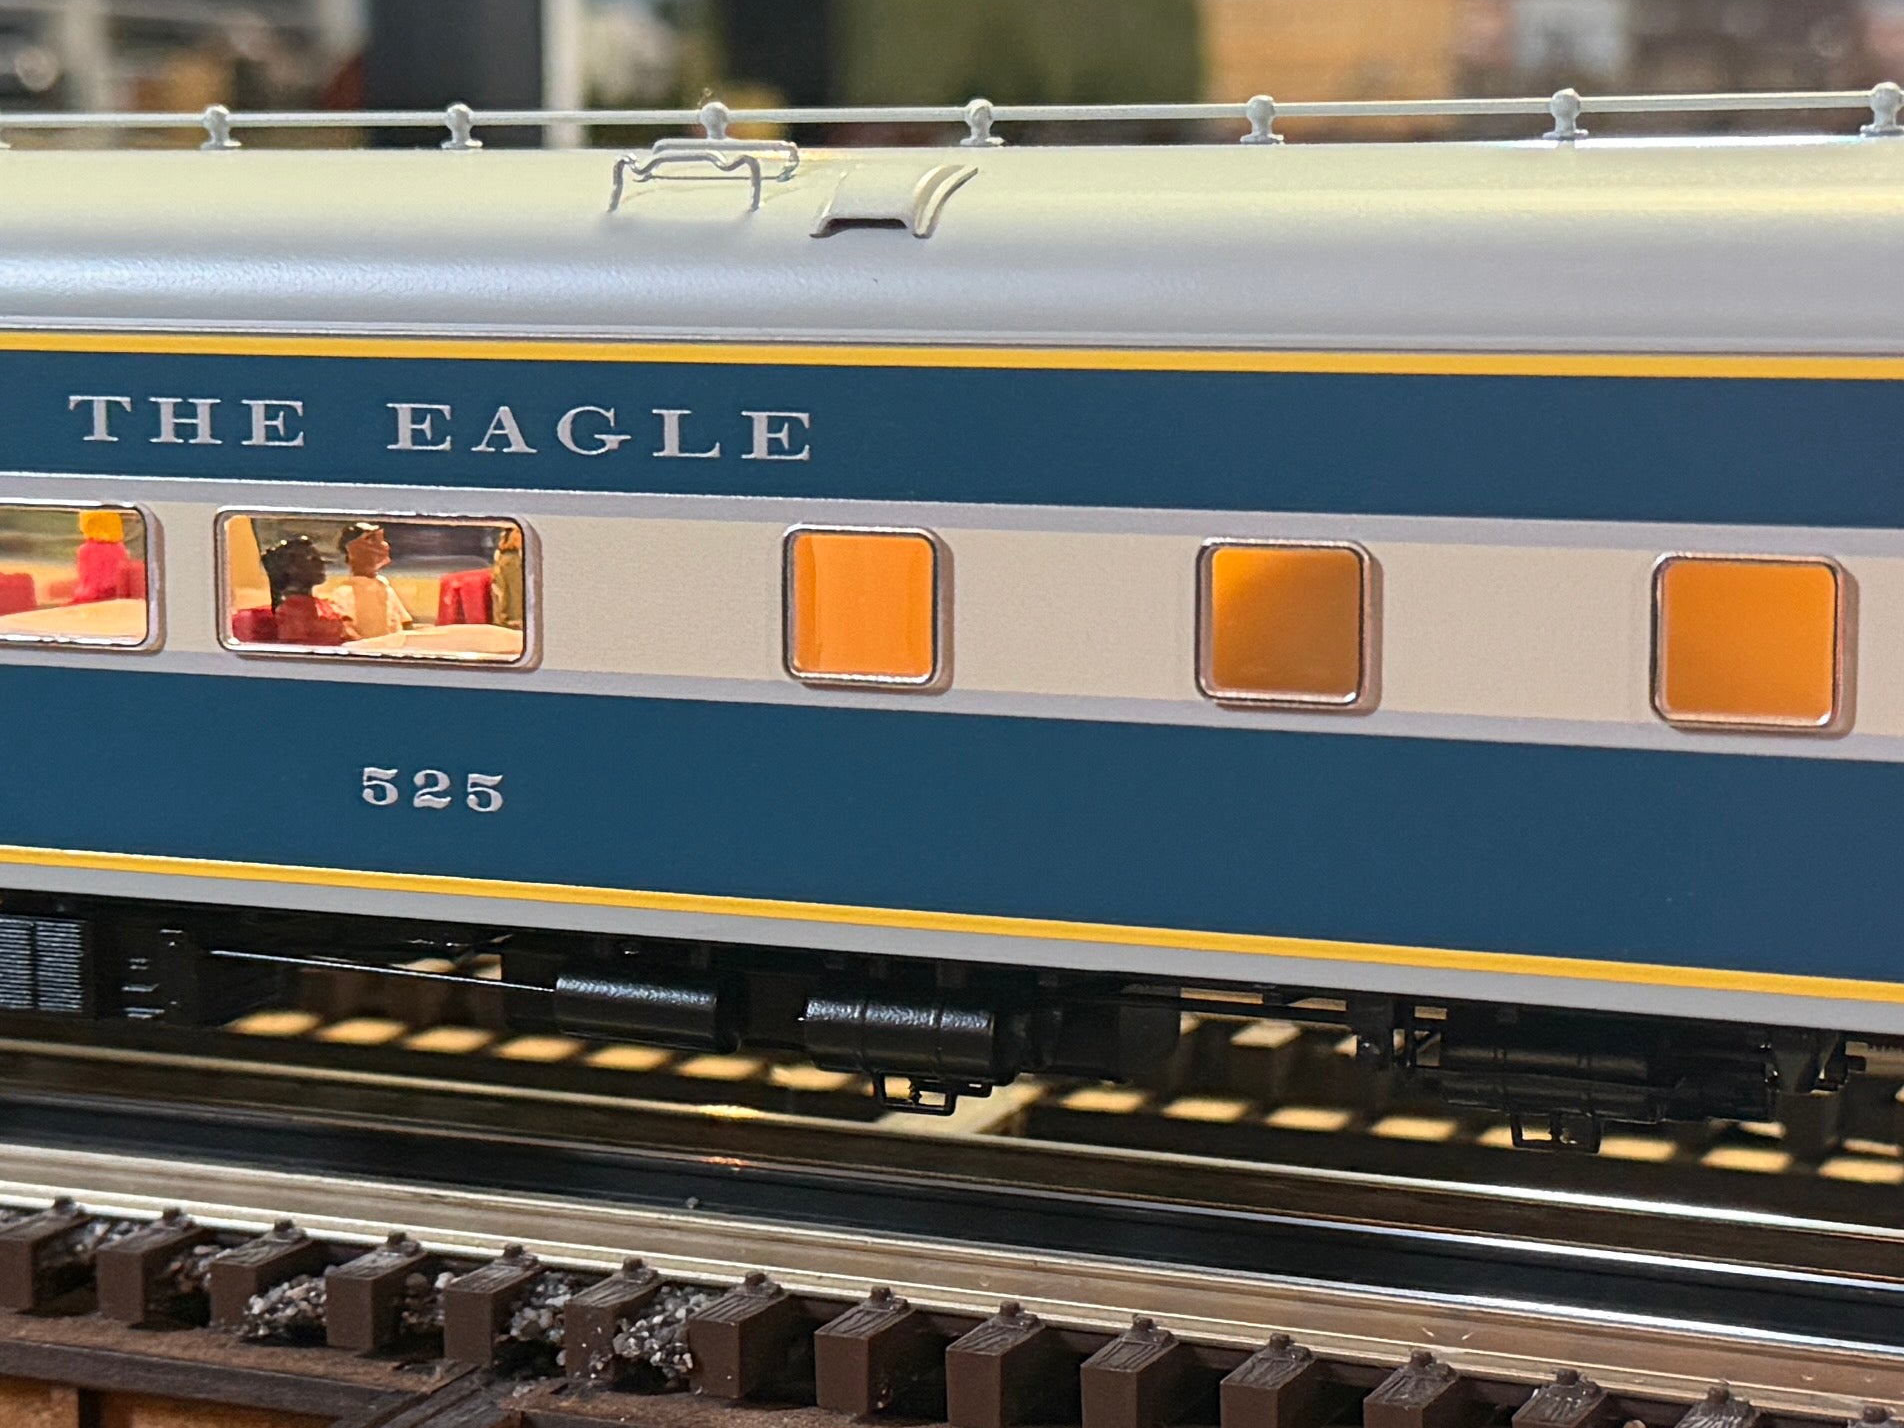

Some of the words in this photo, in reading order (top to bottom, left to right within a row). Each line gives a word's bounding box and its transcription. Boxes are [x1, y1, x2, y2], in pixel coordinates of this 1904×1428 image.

[68, 395, 304, 447] THE
[386, 402, 812, 461] EAGLE
[361, 766, 504, 813] 525
